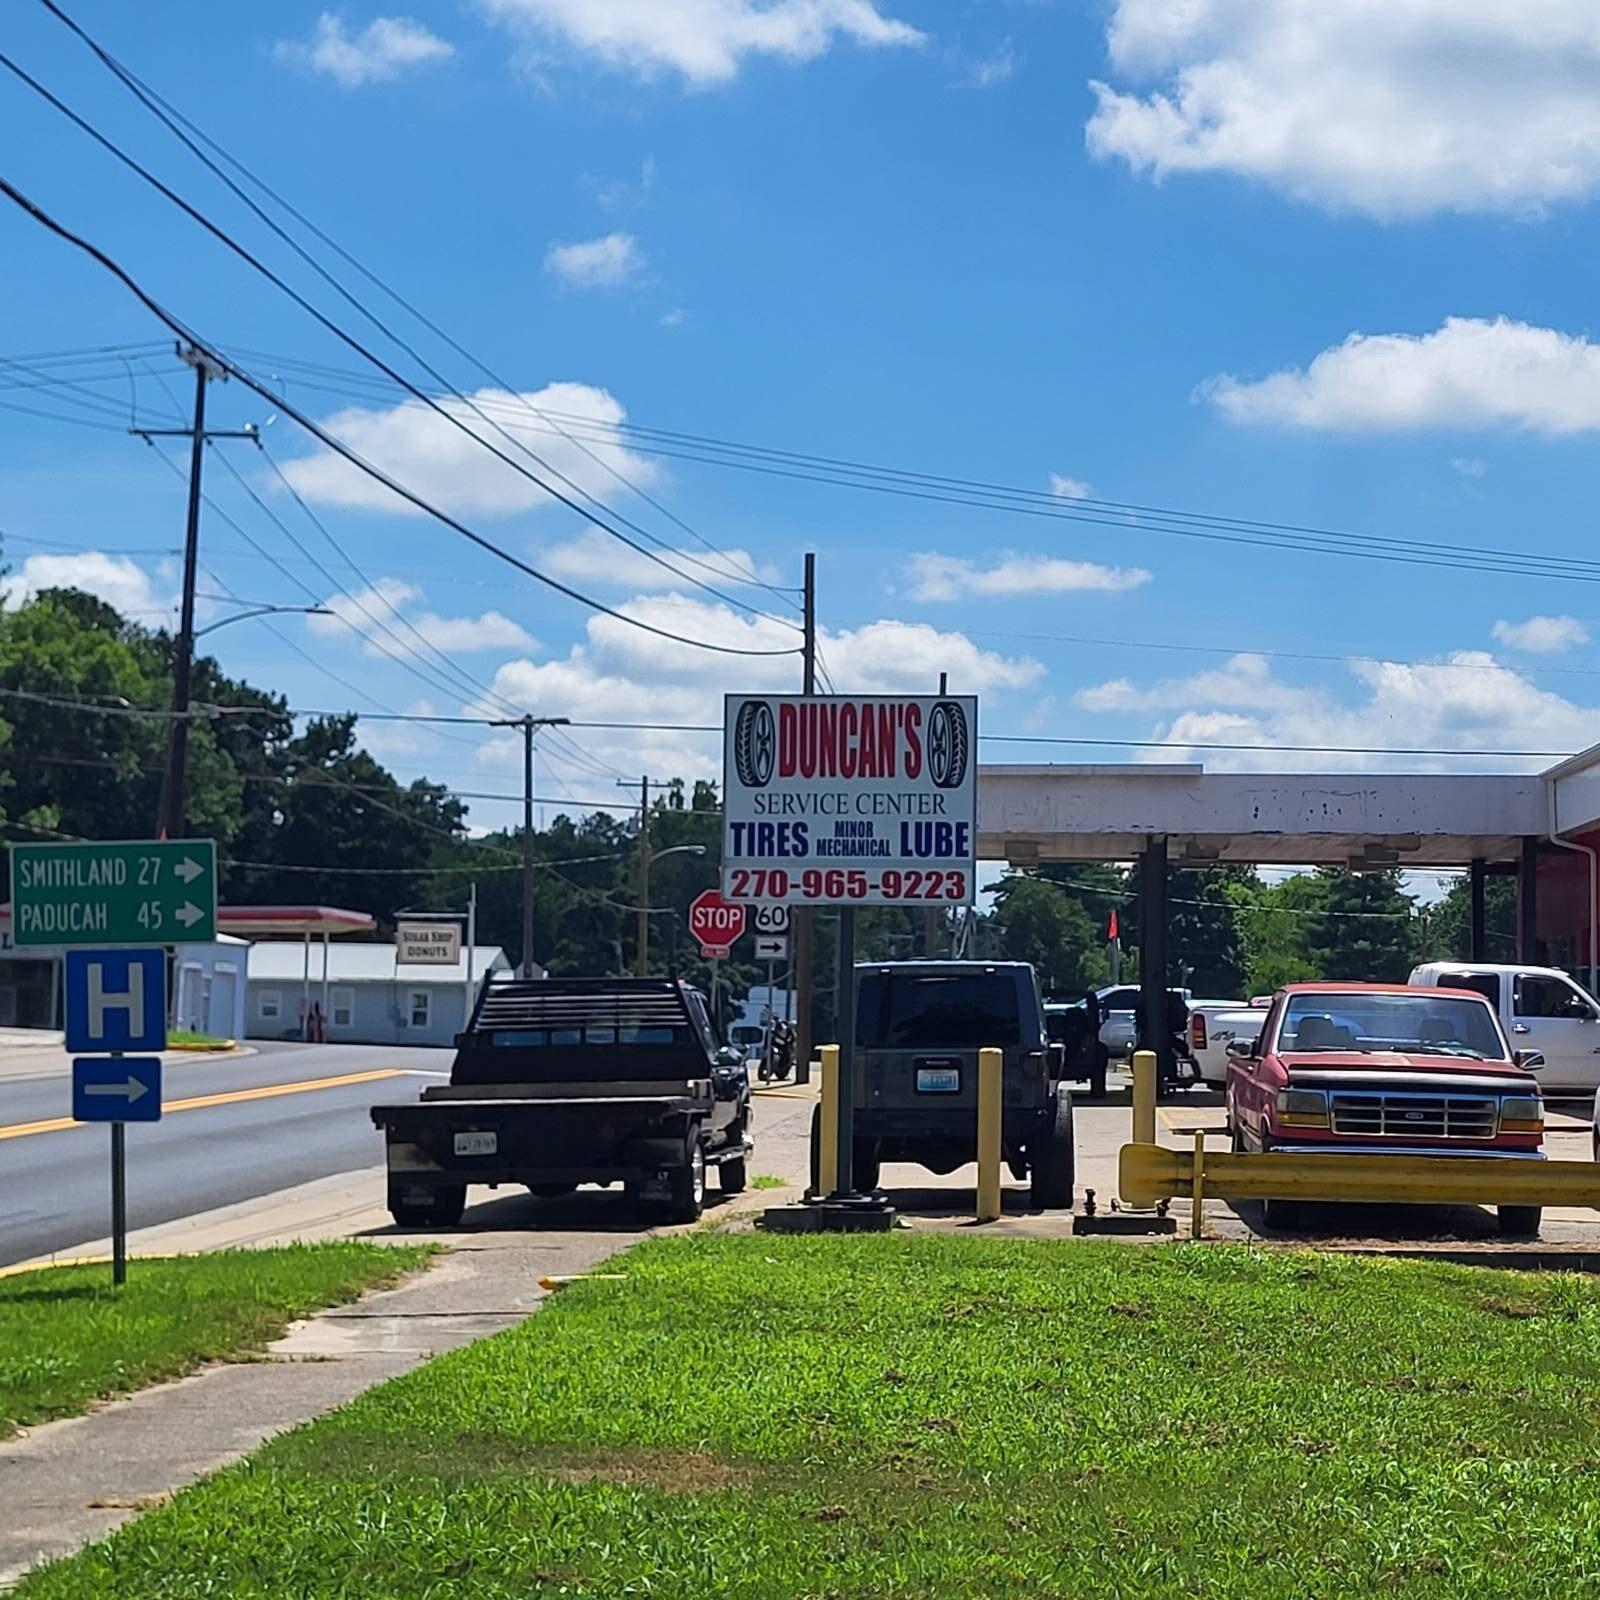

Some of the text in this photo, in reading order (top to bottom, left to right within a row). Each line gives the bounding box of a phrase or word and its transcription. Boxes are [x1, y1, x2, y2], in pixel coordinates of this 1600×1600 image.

[779, 702, 922, 779] DUNCAN'S
[754, 793, 946, 815] SERVICE CENTER
[729, 822, 809, 857] TIRES
[834, 820, 874, 838] MINOR
[900, 822, 969, 857] LUBE
[816, 839, 891, 857] MECHANICAL
[20, 857, 162, 888] SMITHLAND 27
[731, 869, 966, 900] 270-965-9223
[20, 901, 163, 932] PADUCAH 45
[694, 907, 741, 928] STOP
[759, 906, 785, 926] 60
[408, 946, 448, 957] DONUTS
[87, 962, 144, 1038] H
